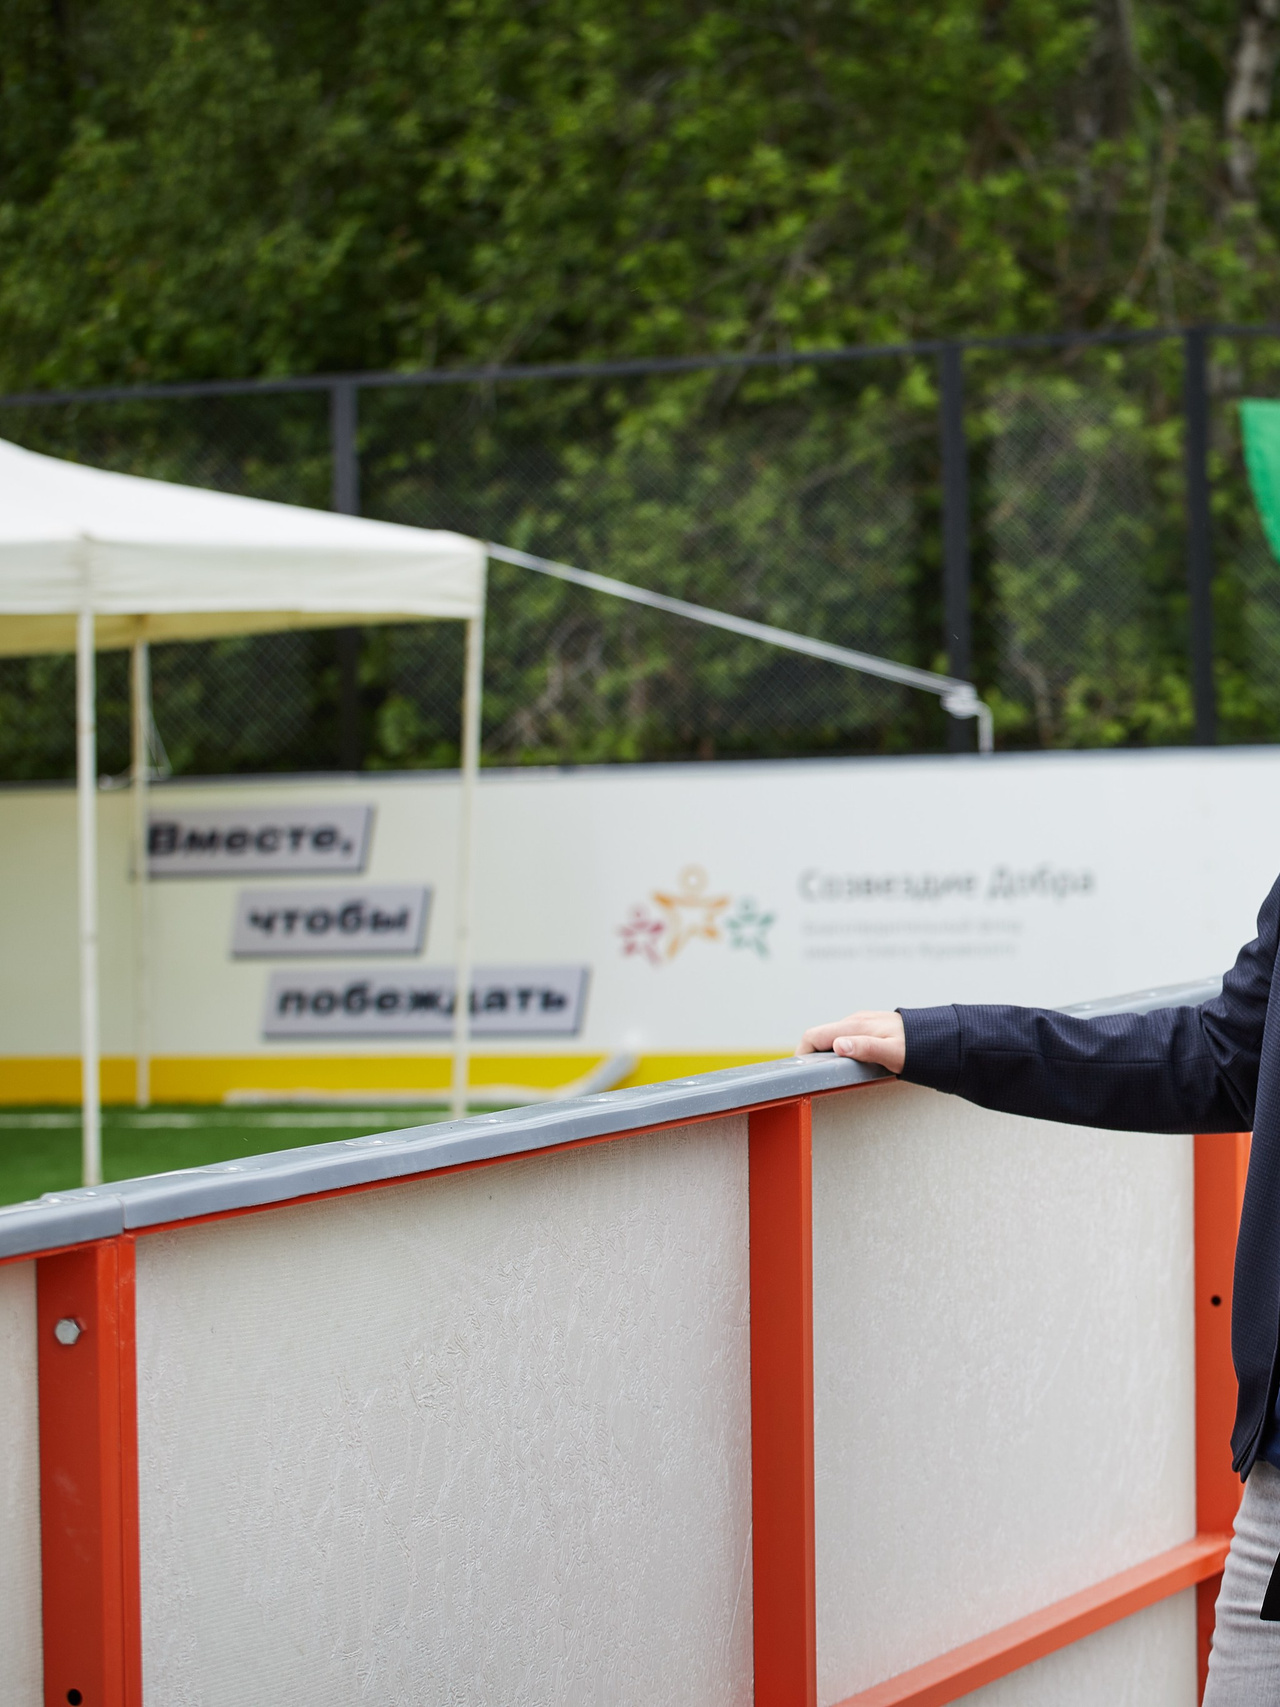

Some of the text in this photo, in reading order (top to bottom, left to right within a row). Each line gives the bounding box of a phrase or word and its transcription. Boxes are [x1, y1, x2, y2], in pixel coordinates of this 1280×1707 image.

[147, 819, 353, 858] Вместе,
[988, 863, 1095, 904] Добра
[248, 900, 410, 935] чтобы
